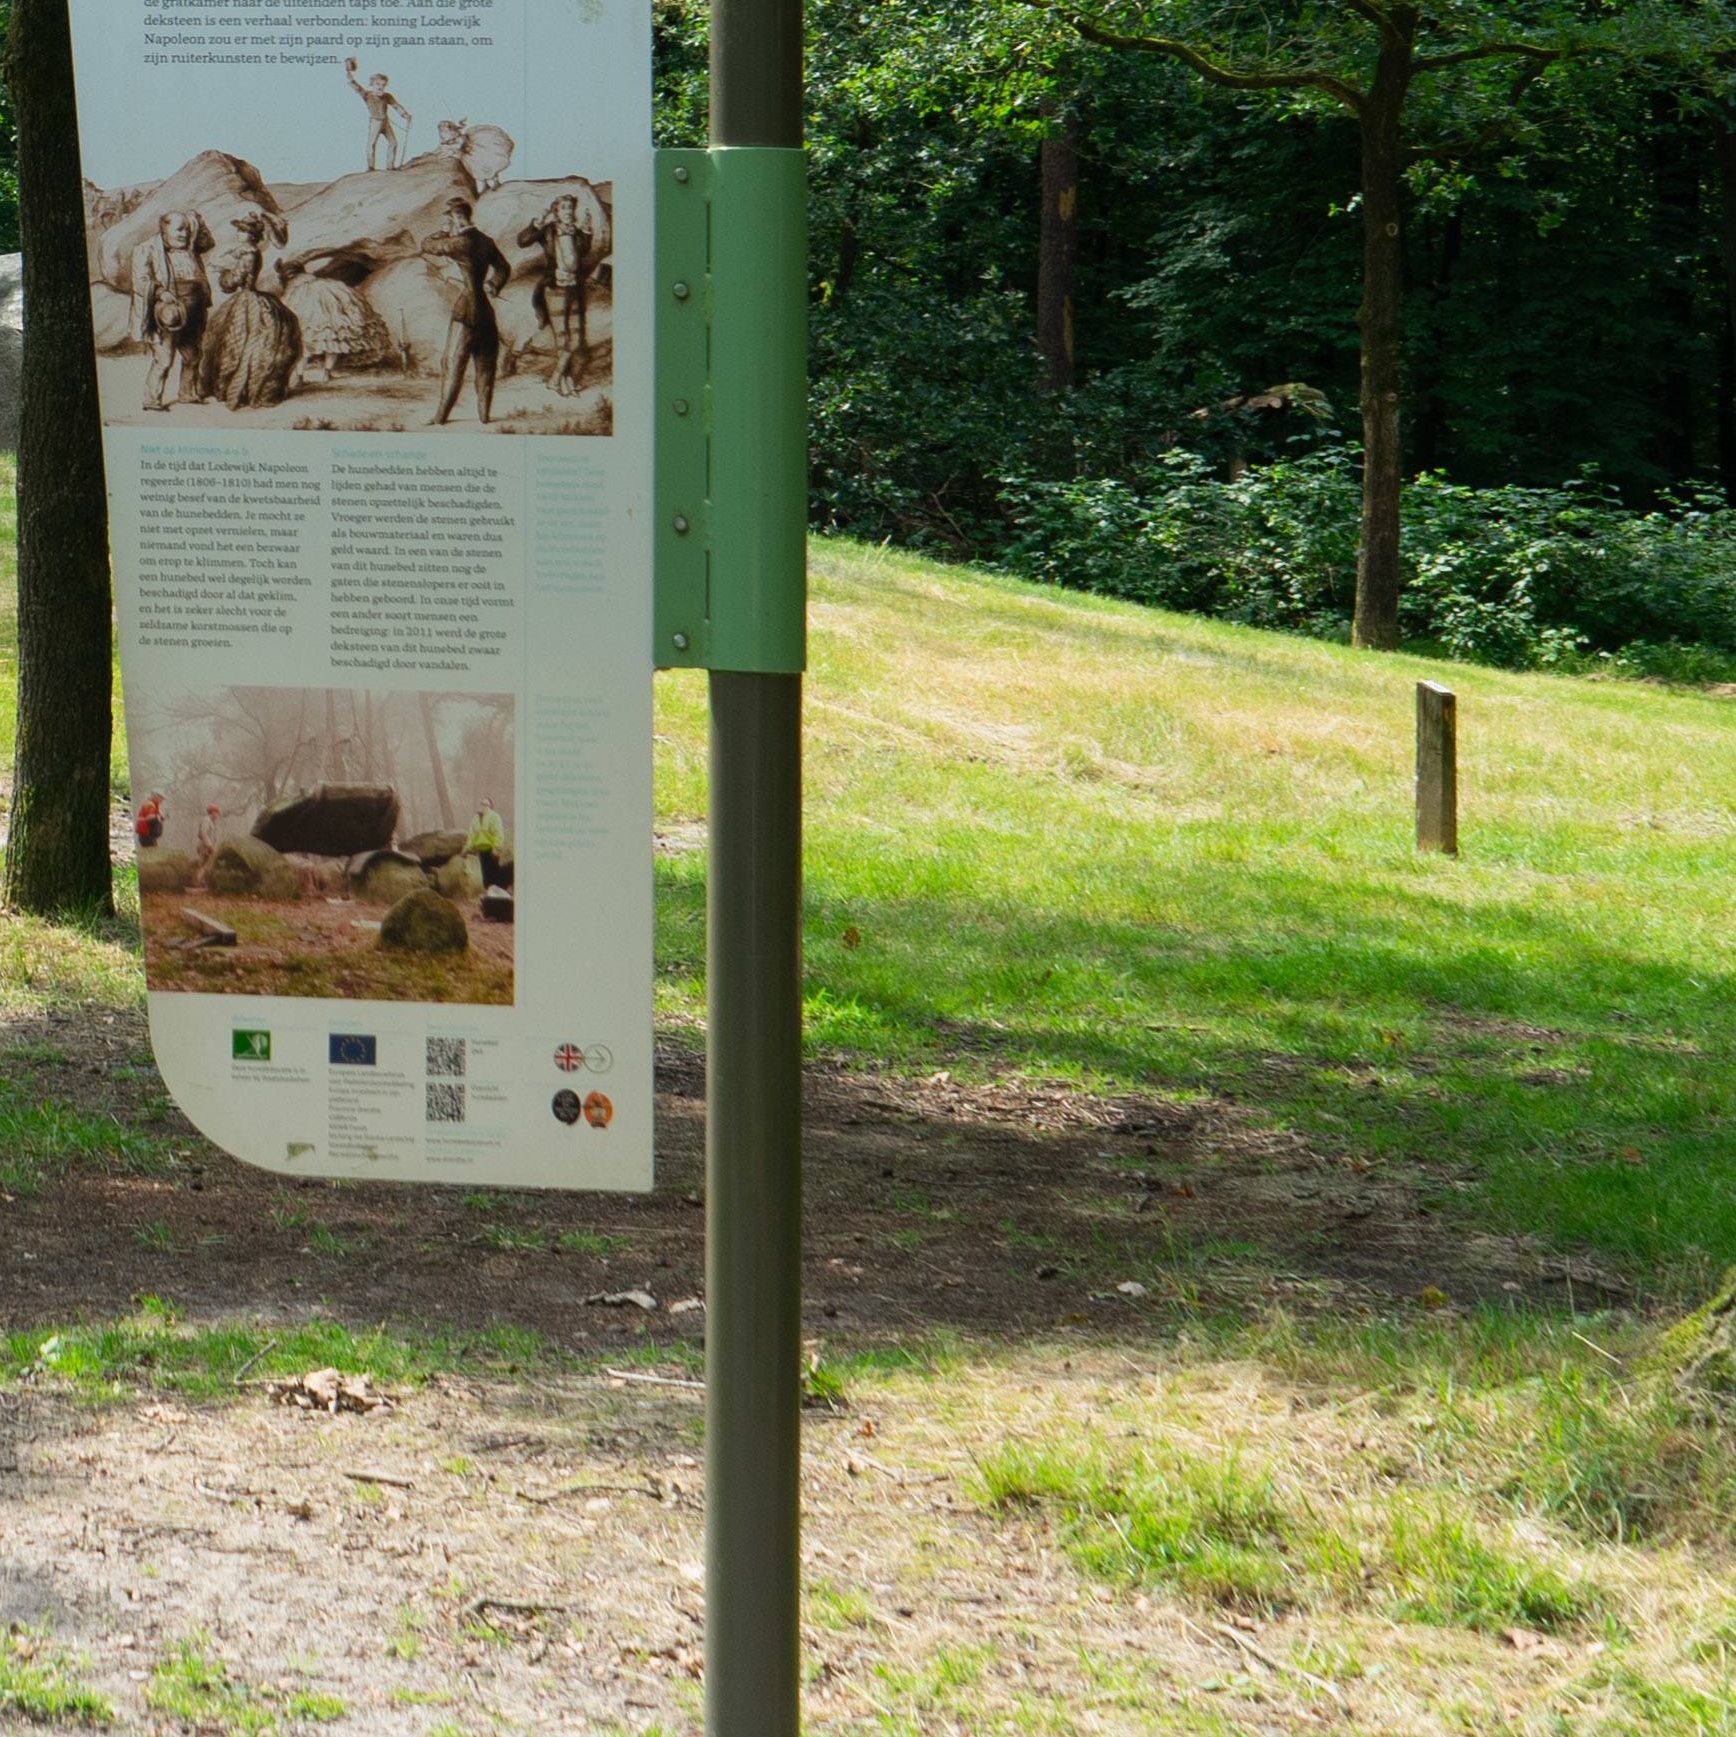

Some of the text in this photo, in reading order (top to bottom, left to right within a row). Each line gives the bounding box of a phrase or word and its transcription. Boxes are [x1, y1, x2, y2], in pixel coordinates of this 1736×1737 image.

[143, 13, 481, 30] deksteen is een verhaal verbonden: koning Lodewijk
[144, 31, 493, 48] Napoleon zou er met zijn paard op zijn gaan staan, om
[143, 51, 340, 67] zijn ruiterkunsten te bewijzen.
